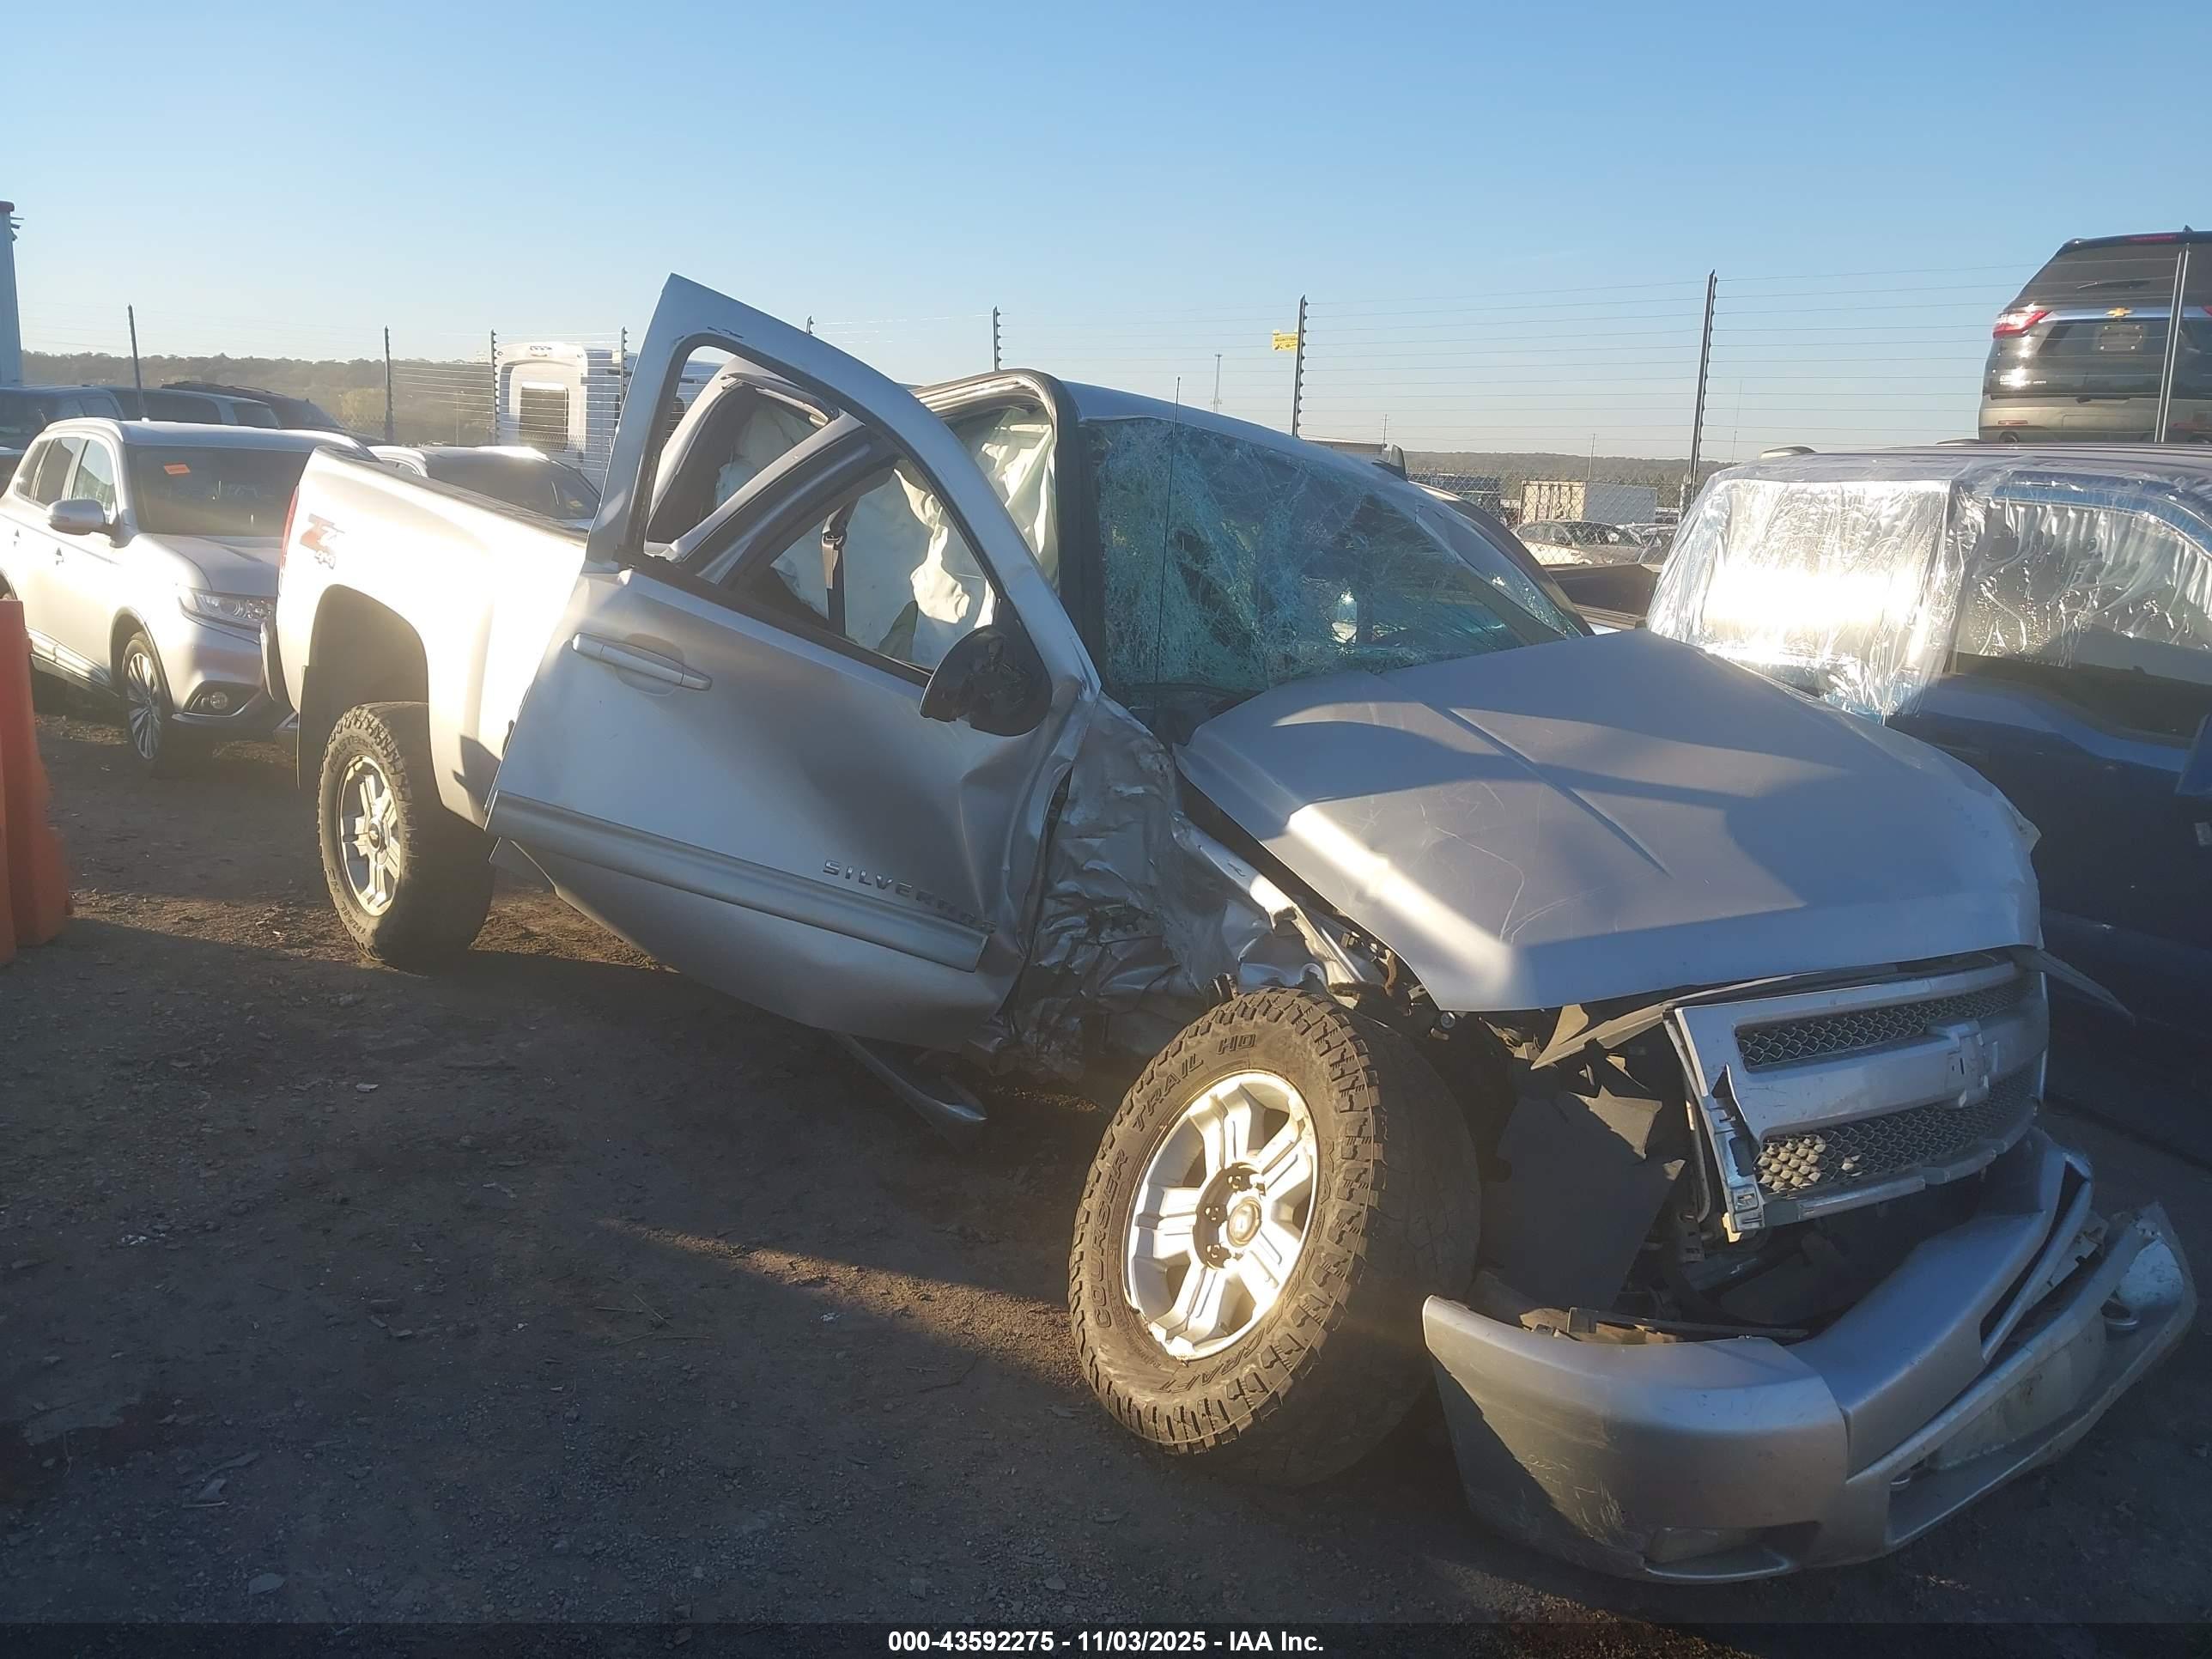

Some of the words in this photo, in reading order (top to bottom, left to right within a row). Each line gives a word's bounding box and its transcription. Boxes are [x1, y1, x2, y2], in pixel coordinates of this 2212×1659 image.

[300, 513, 347, 556] Z7
[1091, 1147, 1129, 1328] COURSER
[1131, 1053, 1205, 1133] TRAIL
[1215, 1033, 1257, 1055] HD
